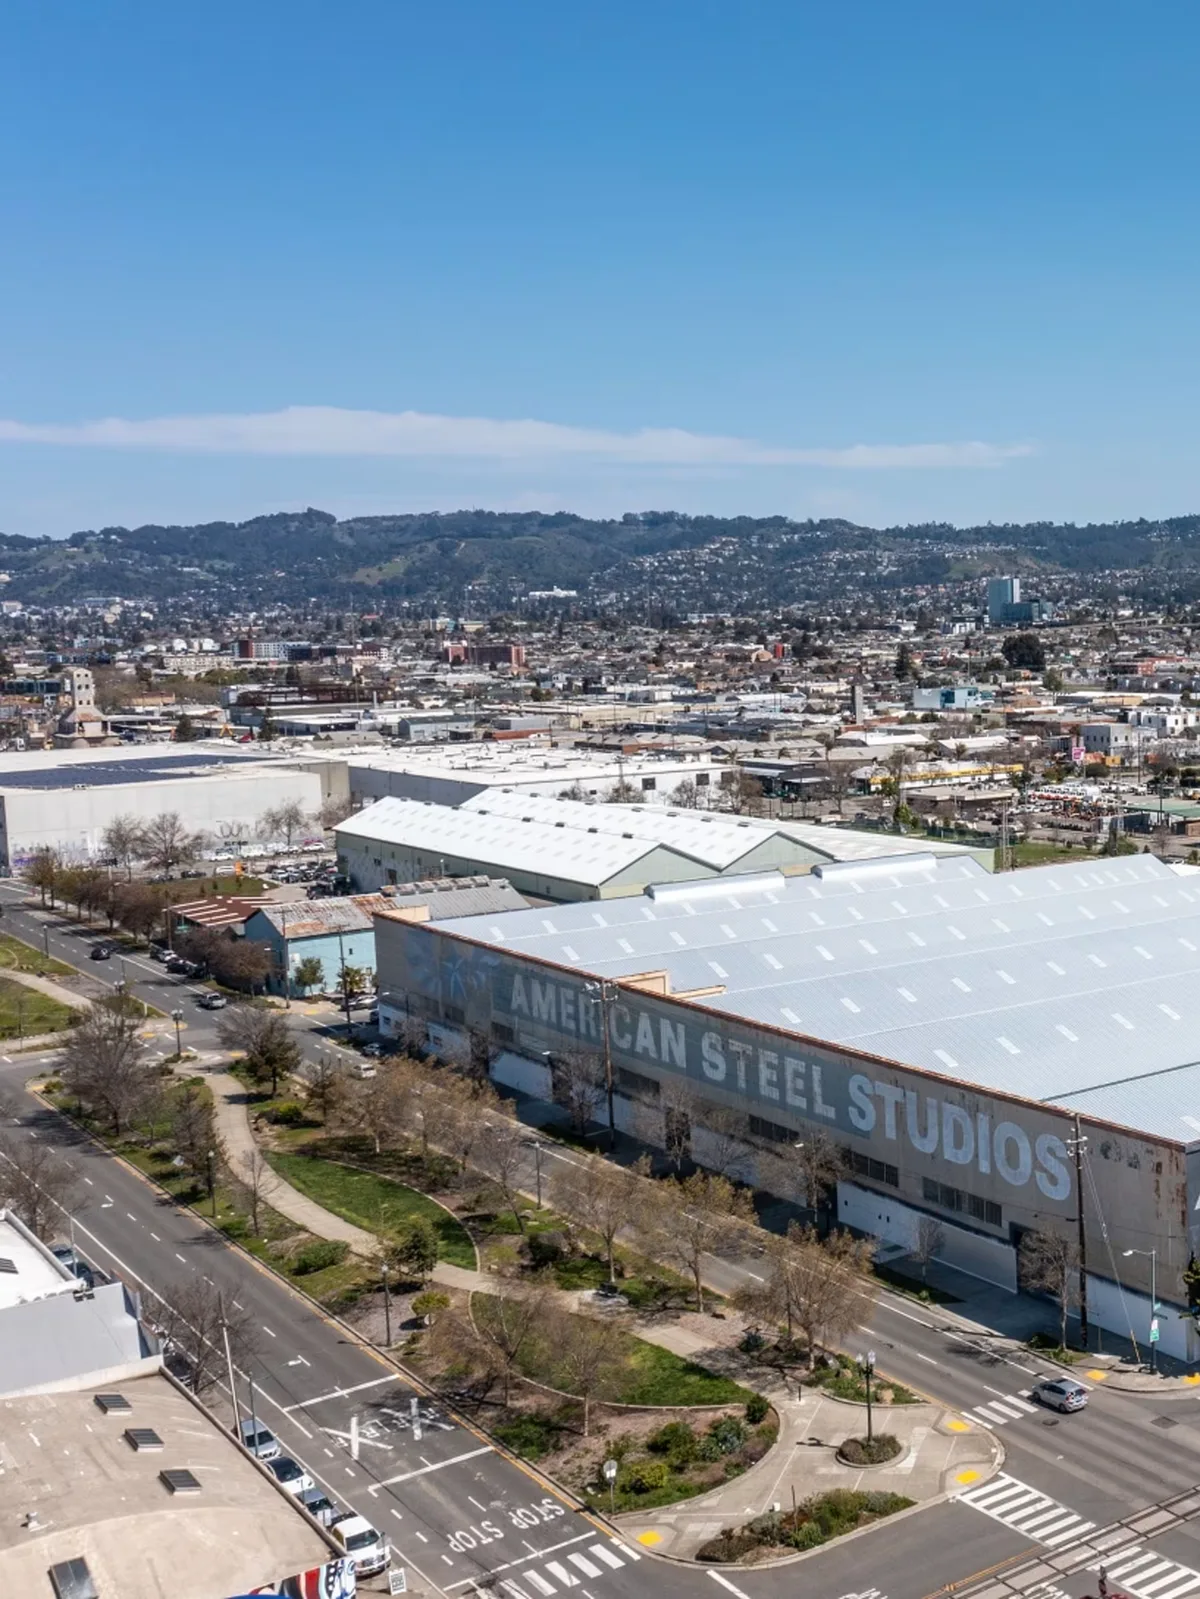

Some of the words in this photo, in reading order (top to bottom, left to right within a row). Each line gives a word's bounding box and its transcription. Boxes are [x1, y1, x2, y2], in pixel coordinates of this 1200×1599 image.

[701, 1031, 836, 1121] STEEL
[847, 1073, 1072, 1201] STUDIOS
[508, 1498, 566, 1529] STOP
[446, 1520, 505, 1553] STOP
